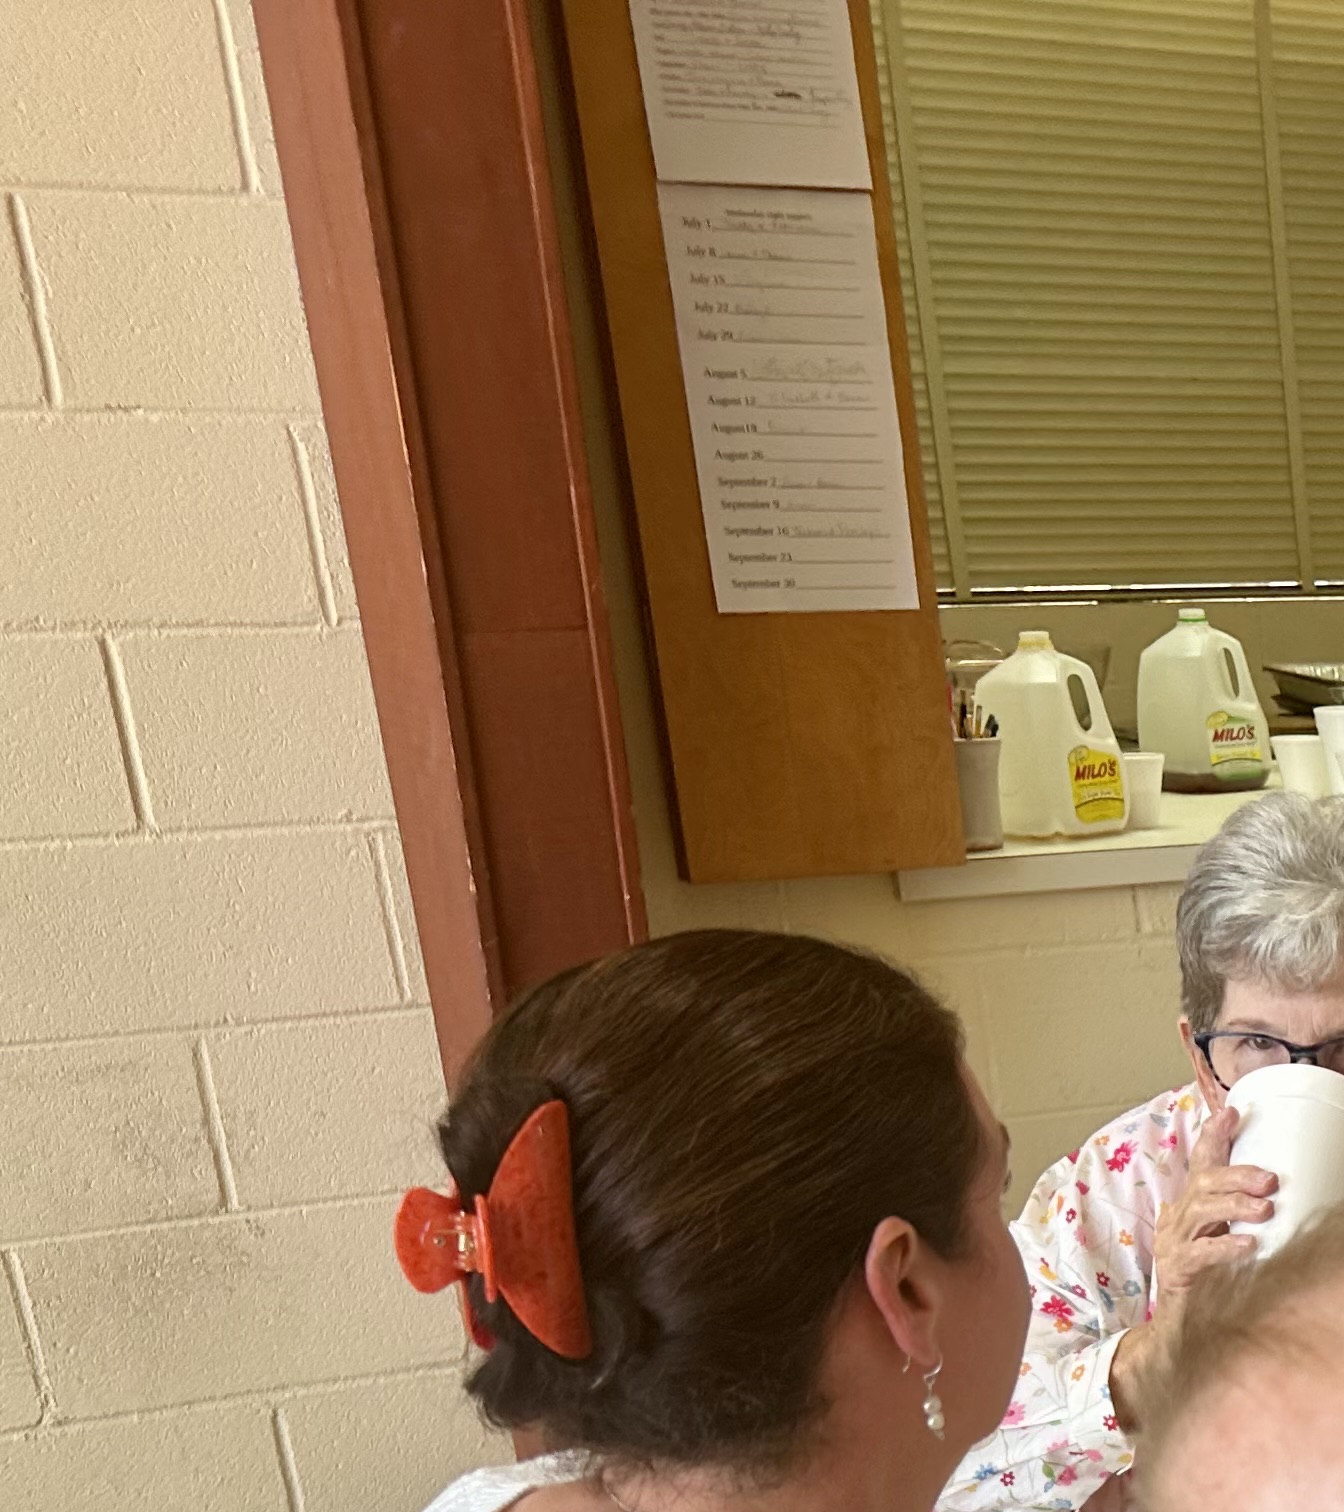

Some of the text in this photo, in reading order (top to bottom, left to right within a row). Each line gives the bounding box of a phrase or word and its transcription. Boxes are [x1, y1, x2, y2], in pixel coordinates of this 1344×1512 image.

[689, 273, 710, 285] July
[694, 302, 714, 313] July
[698, 329, 717, 341] July
[704, 367, 738, 379] August
[708, 395, 742, 407] August
[711, 422, 745, 434] August
[714, 450, 749, 462] August
[718, 477, 768, 489] September
[721, 500, 770, 512] September
[724, 526, 774, 538] September
[777, 527, 789, 536] 16
[728, 552, 777, 565] September
[731, 579, 780, 591] September
[1212, 723, 1255, 742] MILO'S
[1074, 759, 1116, 780] MILO'S
